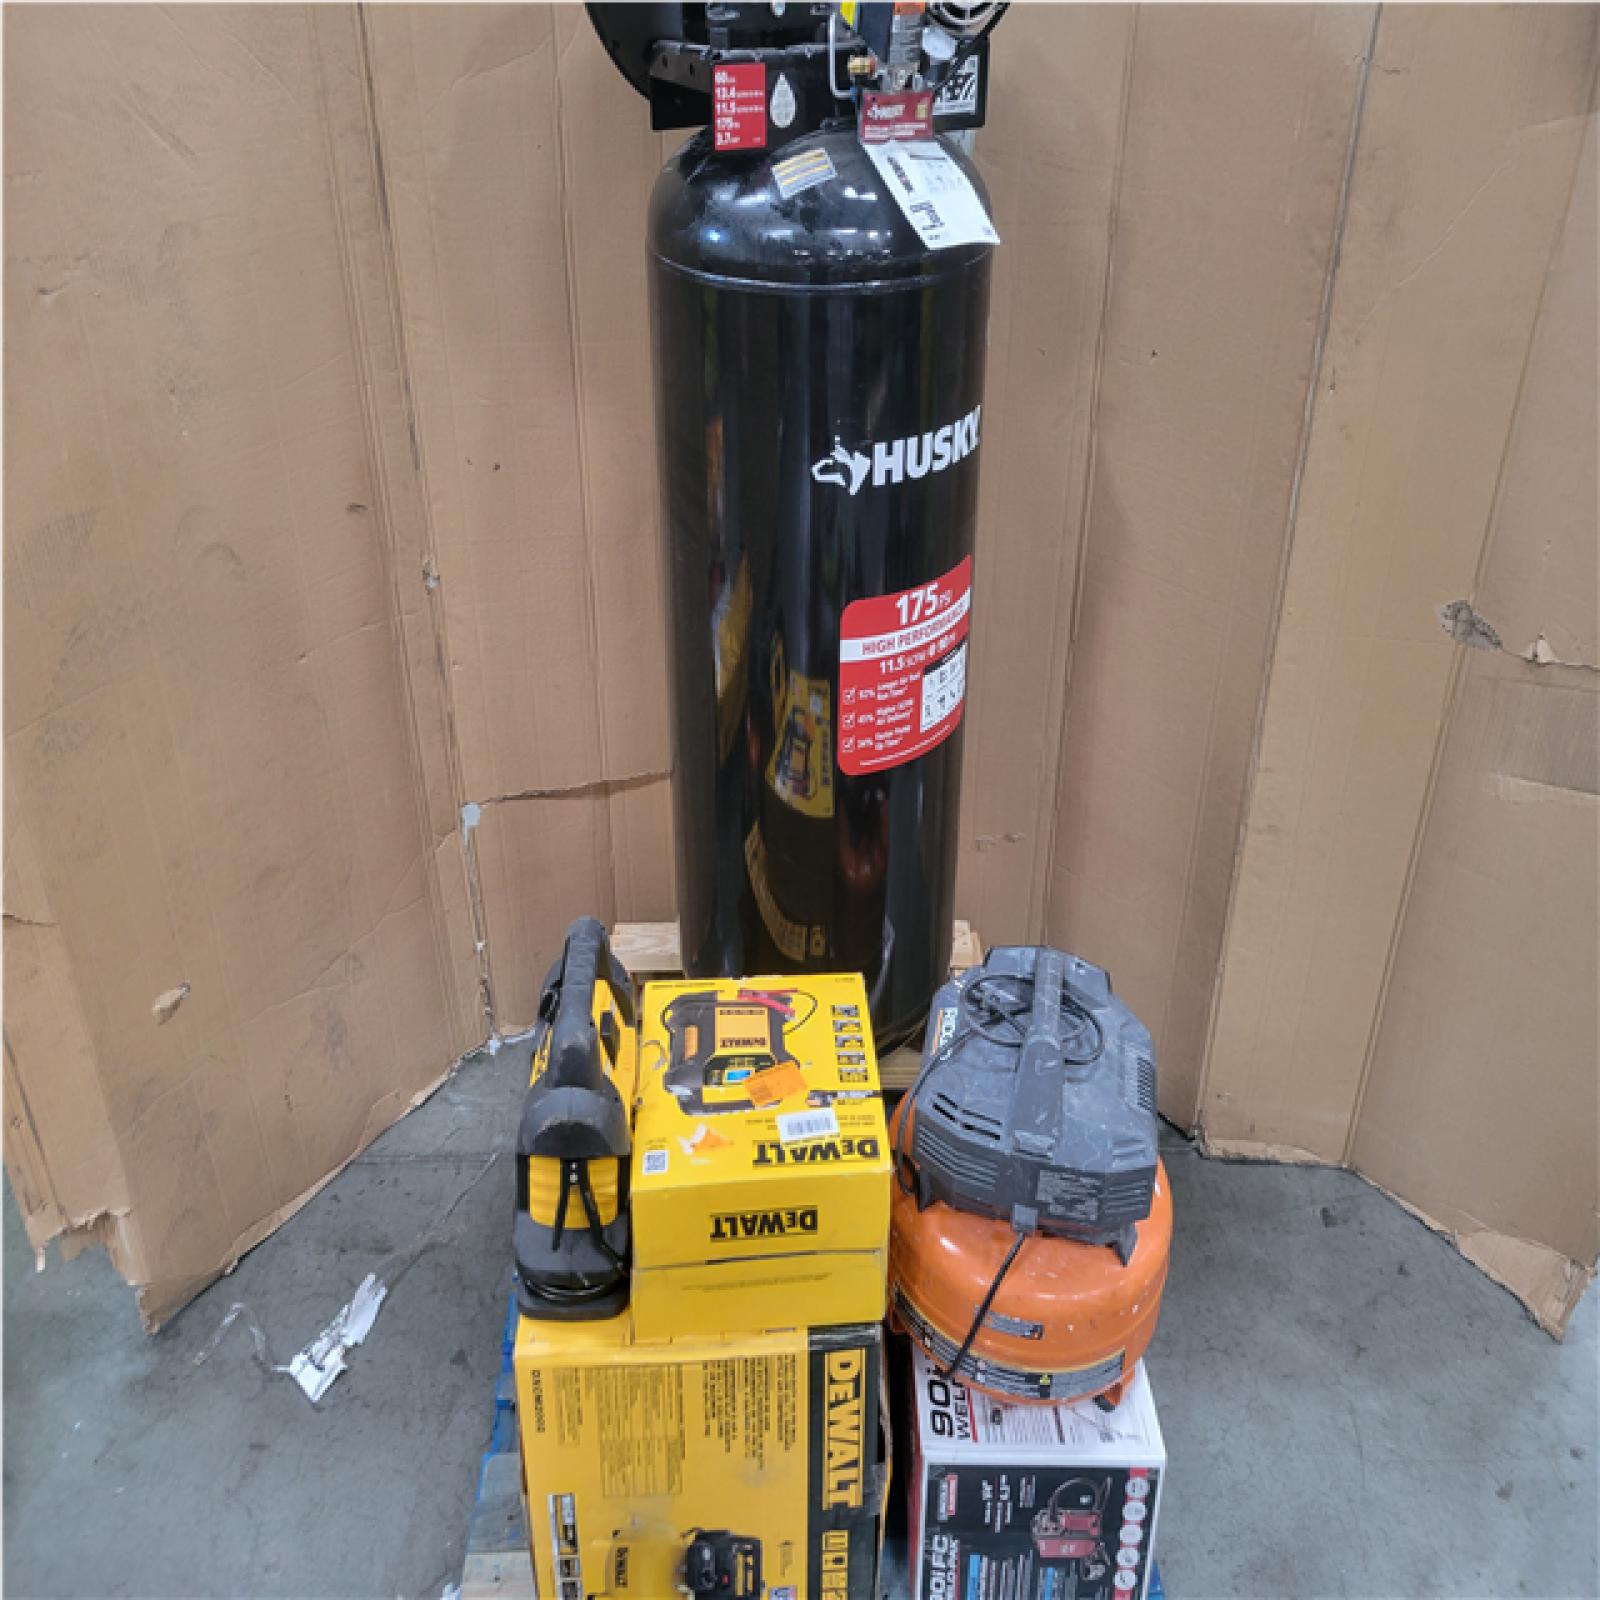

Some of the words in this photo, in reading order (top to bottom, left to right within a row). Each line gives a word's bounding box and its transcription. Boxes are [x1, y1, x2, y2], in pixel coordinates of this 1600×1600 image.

[895, 582, 939, 626] 175
[862, 637, 896, 655] HIGH
[752, 1138, 879, 1168] DEWALT
[711, 1207, 817, 1240] DEWALT
[823, 1349, 864, 1509] DEWALT
